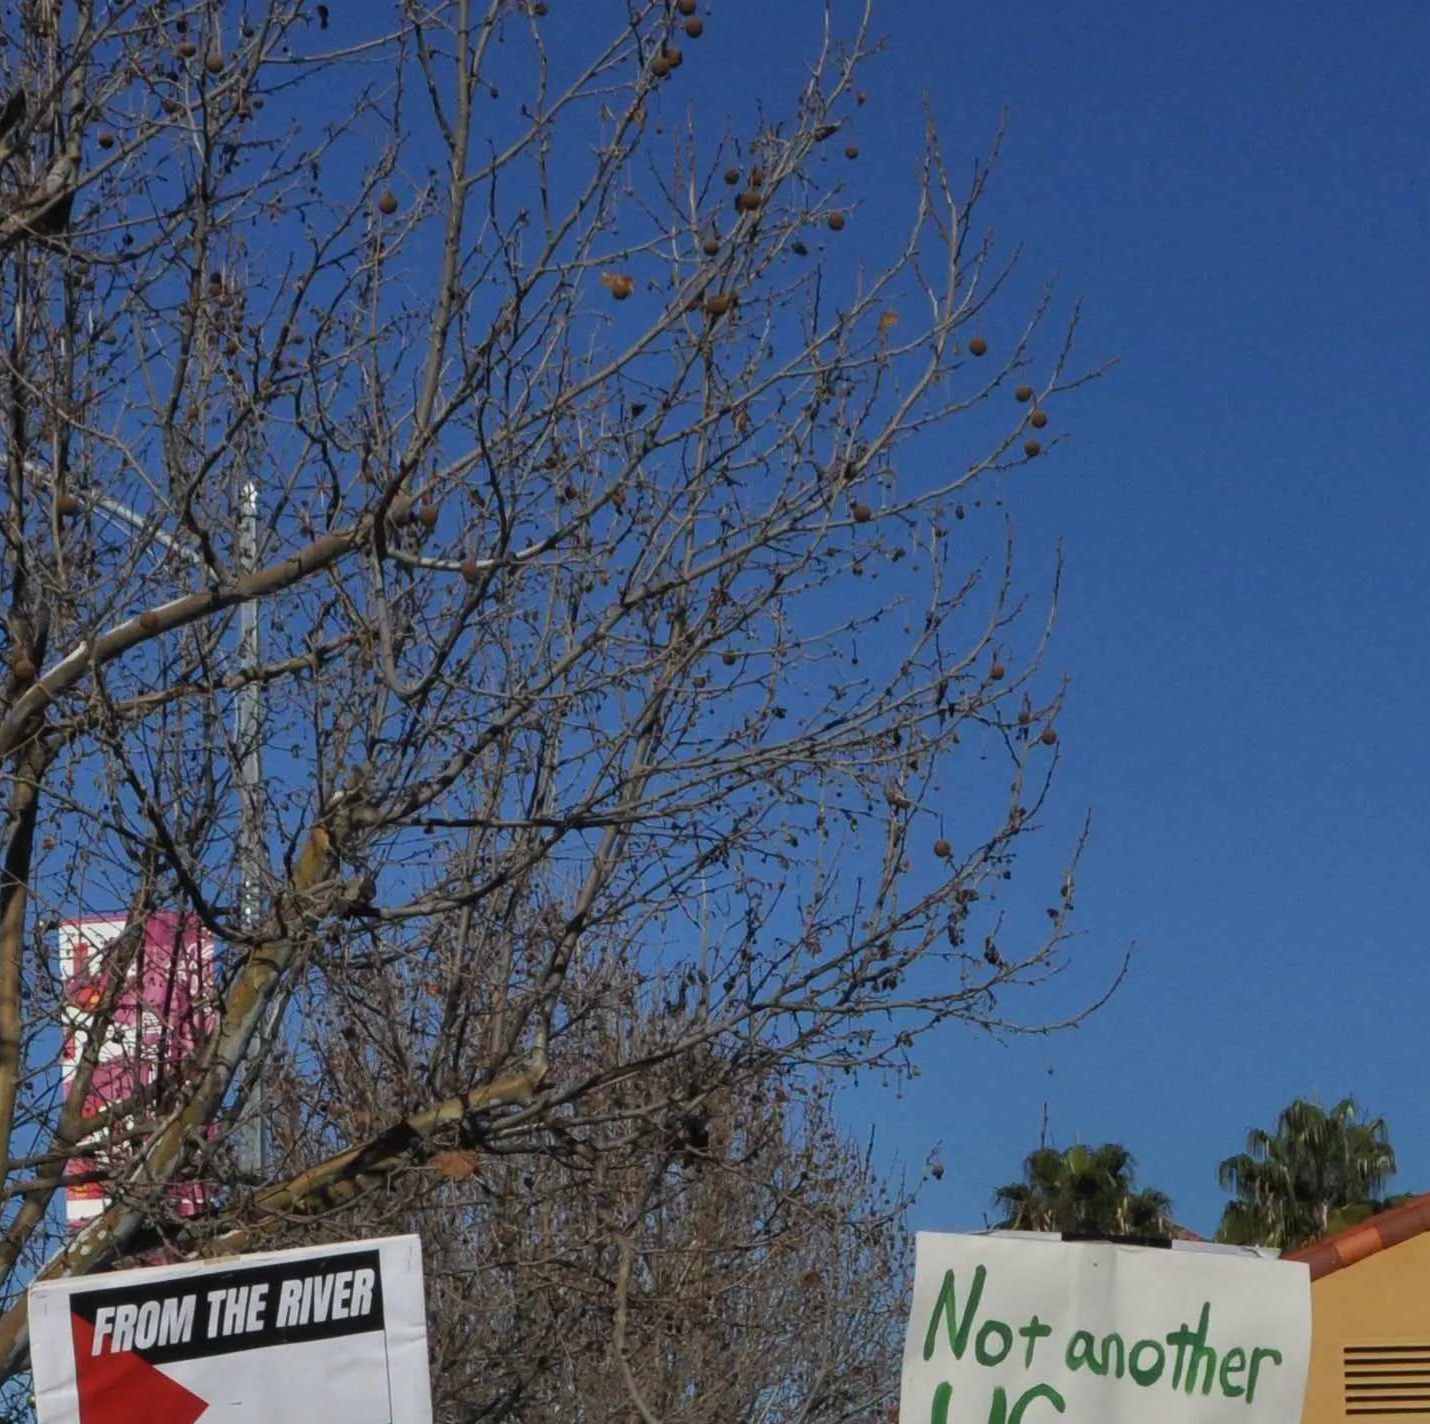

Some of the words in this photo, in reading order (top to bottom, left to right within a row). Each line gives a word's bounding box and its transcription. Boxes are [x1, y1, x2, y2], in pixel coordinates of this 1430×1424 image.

[91, 1293, 196, 1357] FROM
[206, 1283, 270, 1338] THE
[276, 1268, 376, 1329] RIVER
[923, 1264, 1053, 1369] Not
[1065, 1301, 1282, 1403] another
